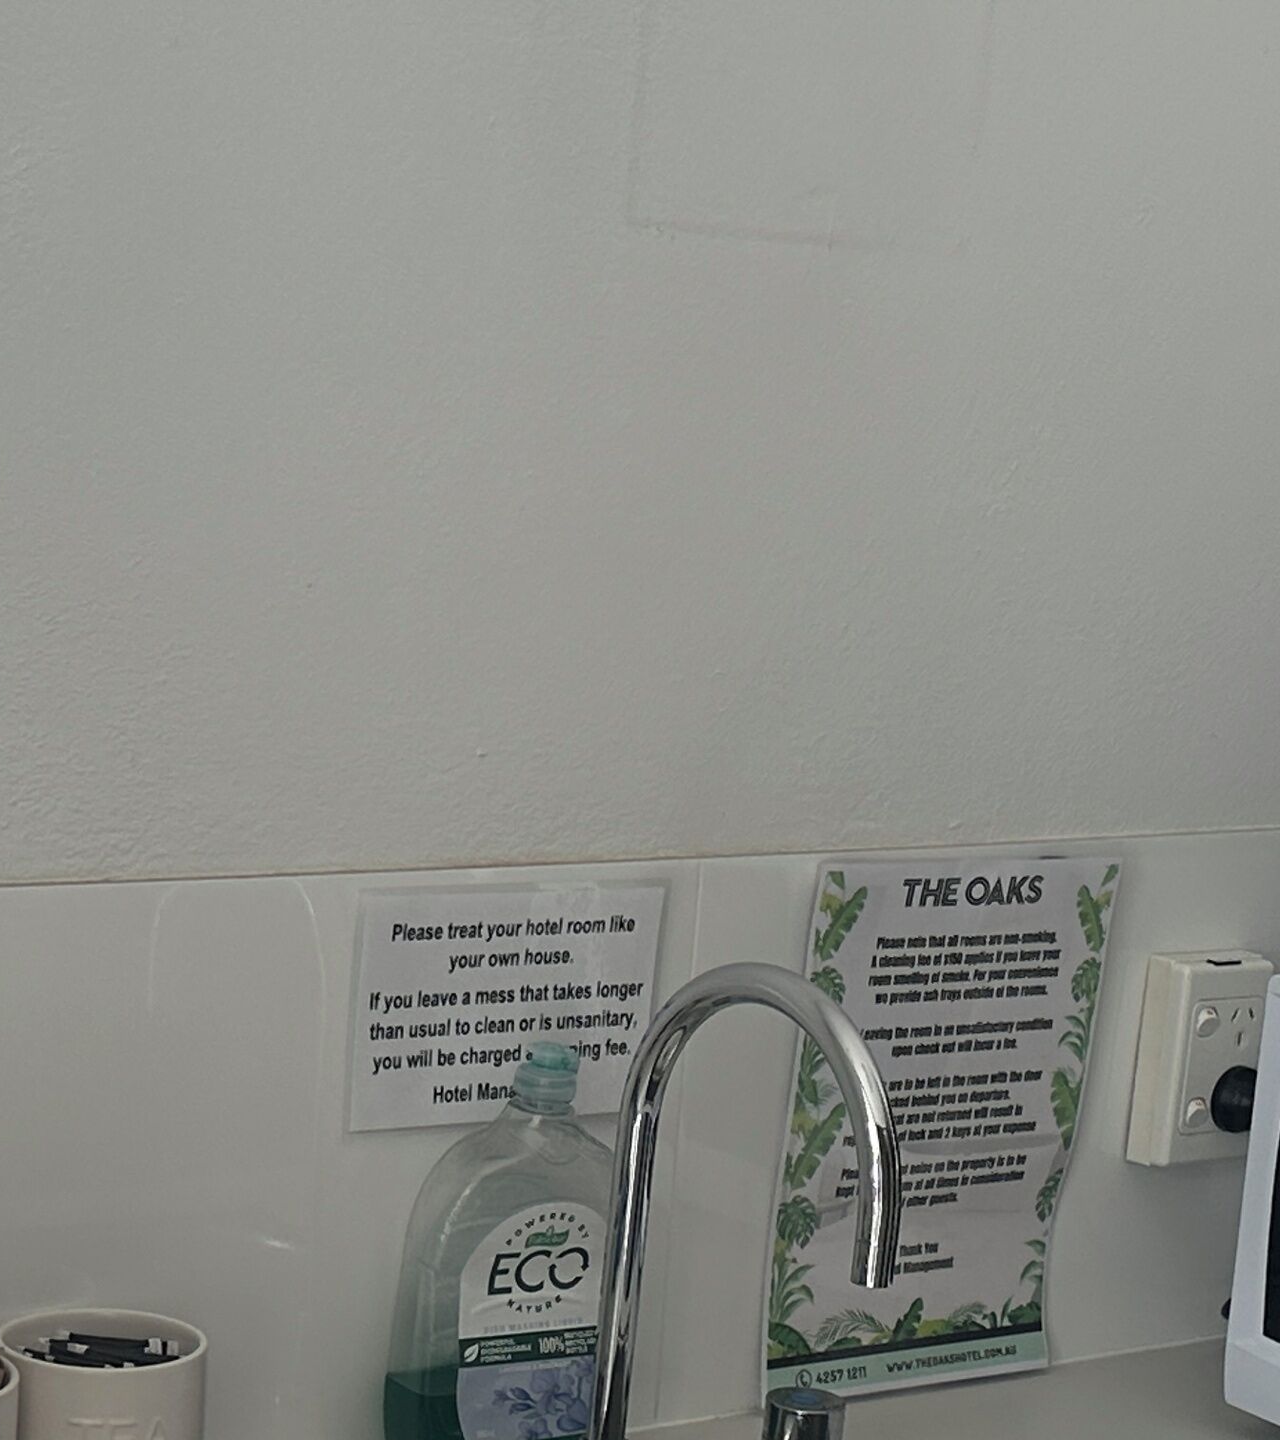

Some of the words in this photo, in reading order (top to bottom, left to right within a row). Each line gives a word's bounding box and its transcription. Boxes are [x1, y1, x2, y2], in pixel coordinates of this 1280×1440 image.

[903, 877, 962, 907] THE
[965, 875, 1044, 906] OAKS
[392, 921, 443, 942] Please
[448, 919, 483, 939] treat
[486, 920, 522, 942] your
[526, 918, 563, 937] hotel
[567, 920, 605, 935] room
[609, 915, 635, 933] like
[877, 937, 905, 949] Please
[907, 936, 927, 948] note
[929, 935, 946, 947] that
[947, 934, 959, 947] all
[960, 935, 987, 946] rooms
[989, 934, 1002, 945] are
[449, 953, 484, 973] your
[489, 952, 519, 966] own
[524, 948, 574, 967] house.
[964, 951, 994, 965] applies
[1003, 951, 1019, 965] you
[1019, 950, 1041, 962] leave
[1042, 949, 1062, 962] your
[868, 975, 892, 987] room
[973, 968, 987, 981] For
[987, 969, 1007, 983] your
[370, 992, 381, 1010] If
[383, 994, 412, 1014] you
[417, 990, 457, 1008] leave
[462, 991, 471, 1005] a
[475, 989, 515, 1004] mess
[520, 985, 549, 1002] that
[553, 982, 591, 1000] takes
[597, 980, 643, 1001] longer
[888, 989, 923, 1006] provide
[939, 988, 963, 1003] trays
[1005, 985, 1021, 998] the
[370, 1023, 404, 1042] than
[409, 1020, 451, 1038] usual
[455, 1020, 470, 1035] to
[475, 1017, 515, 1034] clean
[520, 1018, 536, 1032] or
[539, 1015, 552, 1031] is
[557, 1009, 637, 1031] unsanitary,
[895, 1027, 909, 1039] the
[910, 1027, 933, 1038] room
[1016, 1018, 1053, 1032] condition
[372, 1055, 402, 1075] you
[407, 1051, 433, 1068] will
[437, 1050, 455, 1066] be
[460, 1045, 520, 1066] charged
[605, 1040, 631, 1057] fee.
[892, 1045, 913, 1058] upon
[914, 1042, 940, 1055] check
[958, 1040, 973, 1052] will
[889, 1080, 903, 1092] are
[914, 1078, 925, 1090] be
[952, 1075, 965, 1087] the
[967, 1074, 989, 1086] room
[990, 1071, 1008, 1084] with
[1009, 1070, 1023, 1083] the
[1023, 1069, 1043, 1082] door
[433, 1085, 472, 1104] Hotel
[911, 1093, 940, 1107] behind
[941, 1094, 957, 1106] you
[906, 1113, 920, 1124] are
[937, 1109, 972, 1122] returned
[974, 1107, 989, 1119] will
[908, 1128, 926, 1141] lock
[927, 1127, 943, 1140] and
[952, 1126, 971, 1139] keys
[983, 1124, 1002, 1137] your
[1003, 1121, 1036, 1134] expense
[946, 1160, 960, 1172] the
[961, 1157, 995, 1172] property
[997, 1155, 1006, 1167] is
[1016, 1154, 1027, 1165] be
[936, 1177, 960, 1189] times
[970, 1171, 1024, 1186] consideration
[505, 1213, 576, 1246] POWERED
[487, 1247, 589, 1296] ECO
[903, 1256, 954, 1274] Management
[507, 1294, 562, 1314] NATURE
[539, 1336, 566, 1354] 100%
[816, 1369, 844, 1384] 4257
